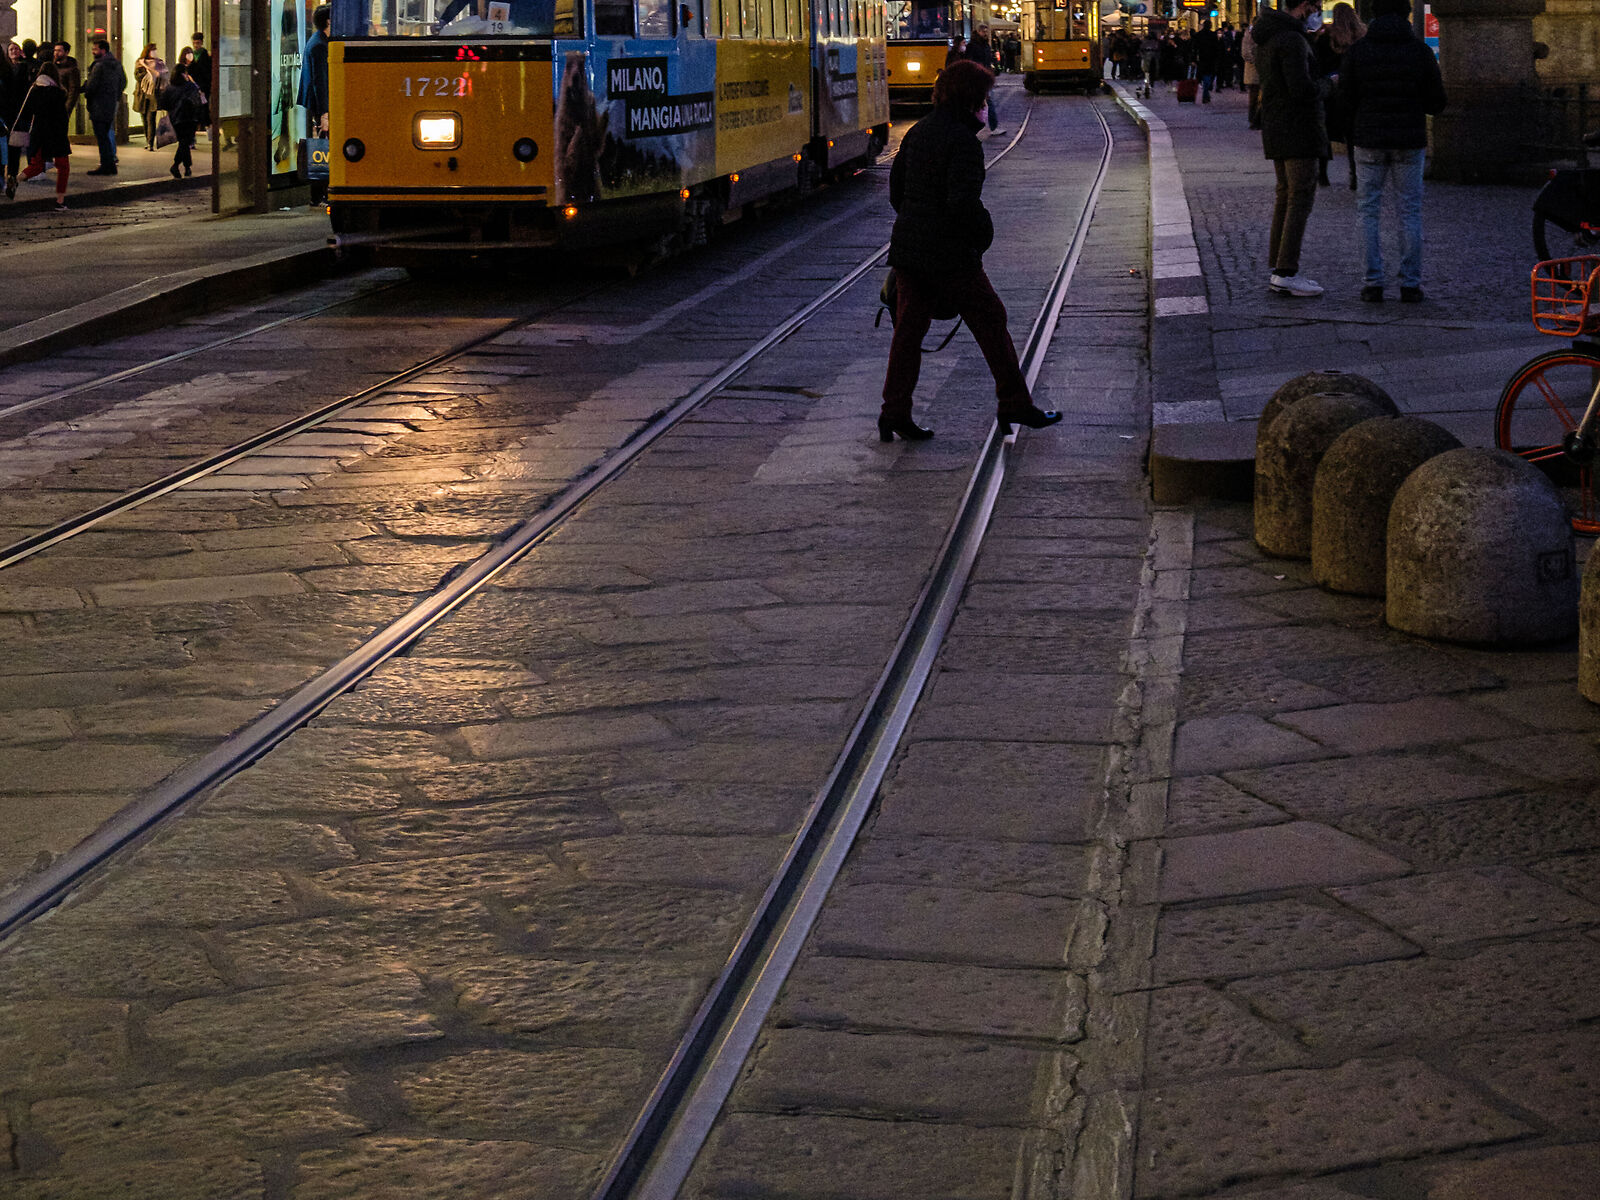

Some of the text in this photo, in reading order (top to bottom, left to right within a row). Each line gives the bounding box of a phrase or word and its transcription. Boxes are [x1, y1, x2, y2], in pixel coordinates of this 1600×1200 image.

[491, 22, 504, 34] 19
[399, 77, 467, 97] 4722
[611, 67, 665, 94] MILANO,
[631, 105, 681, 132] MANGIA
